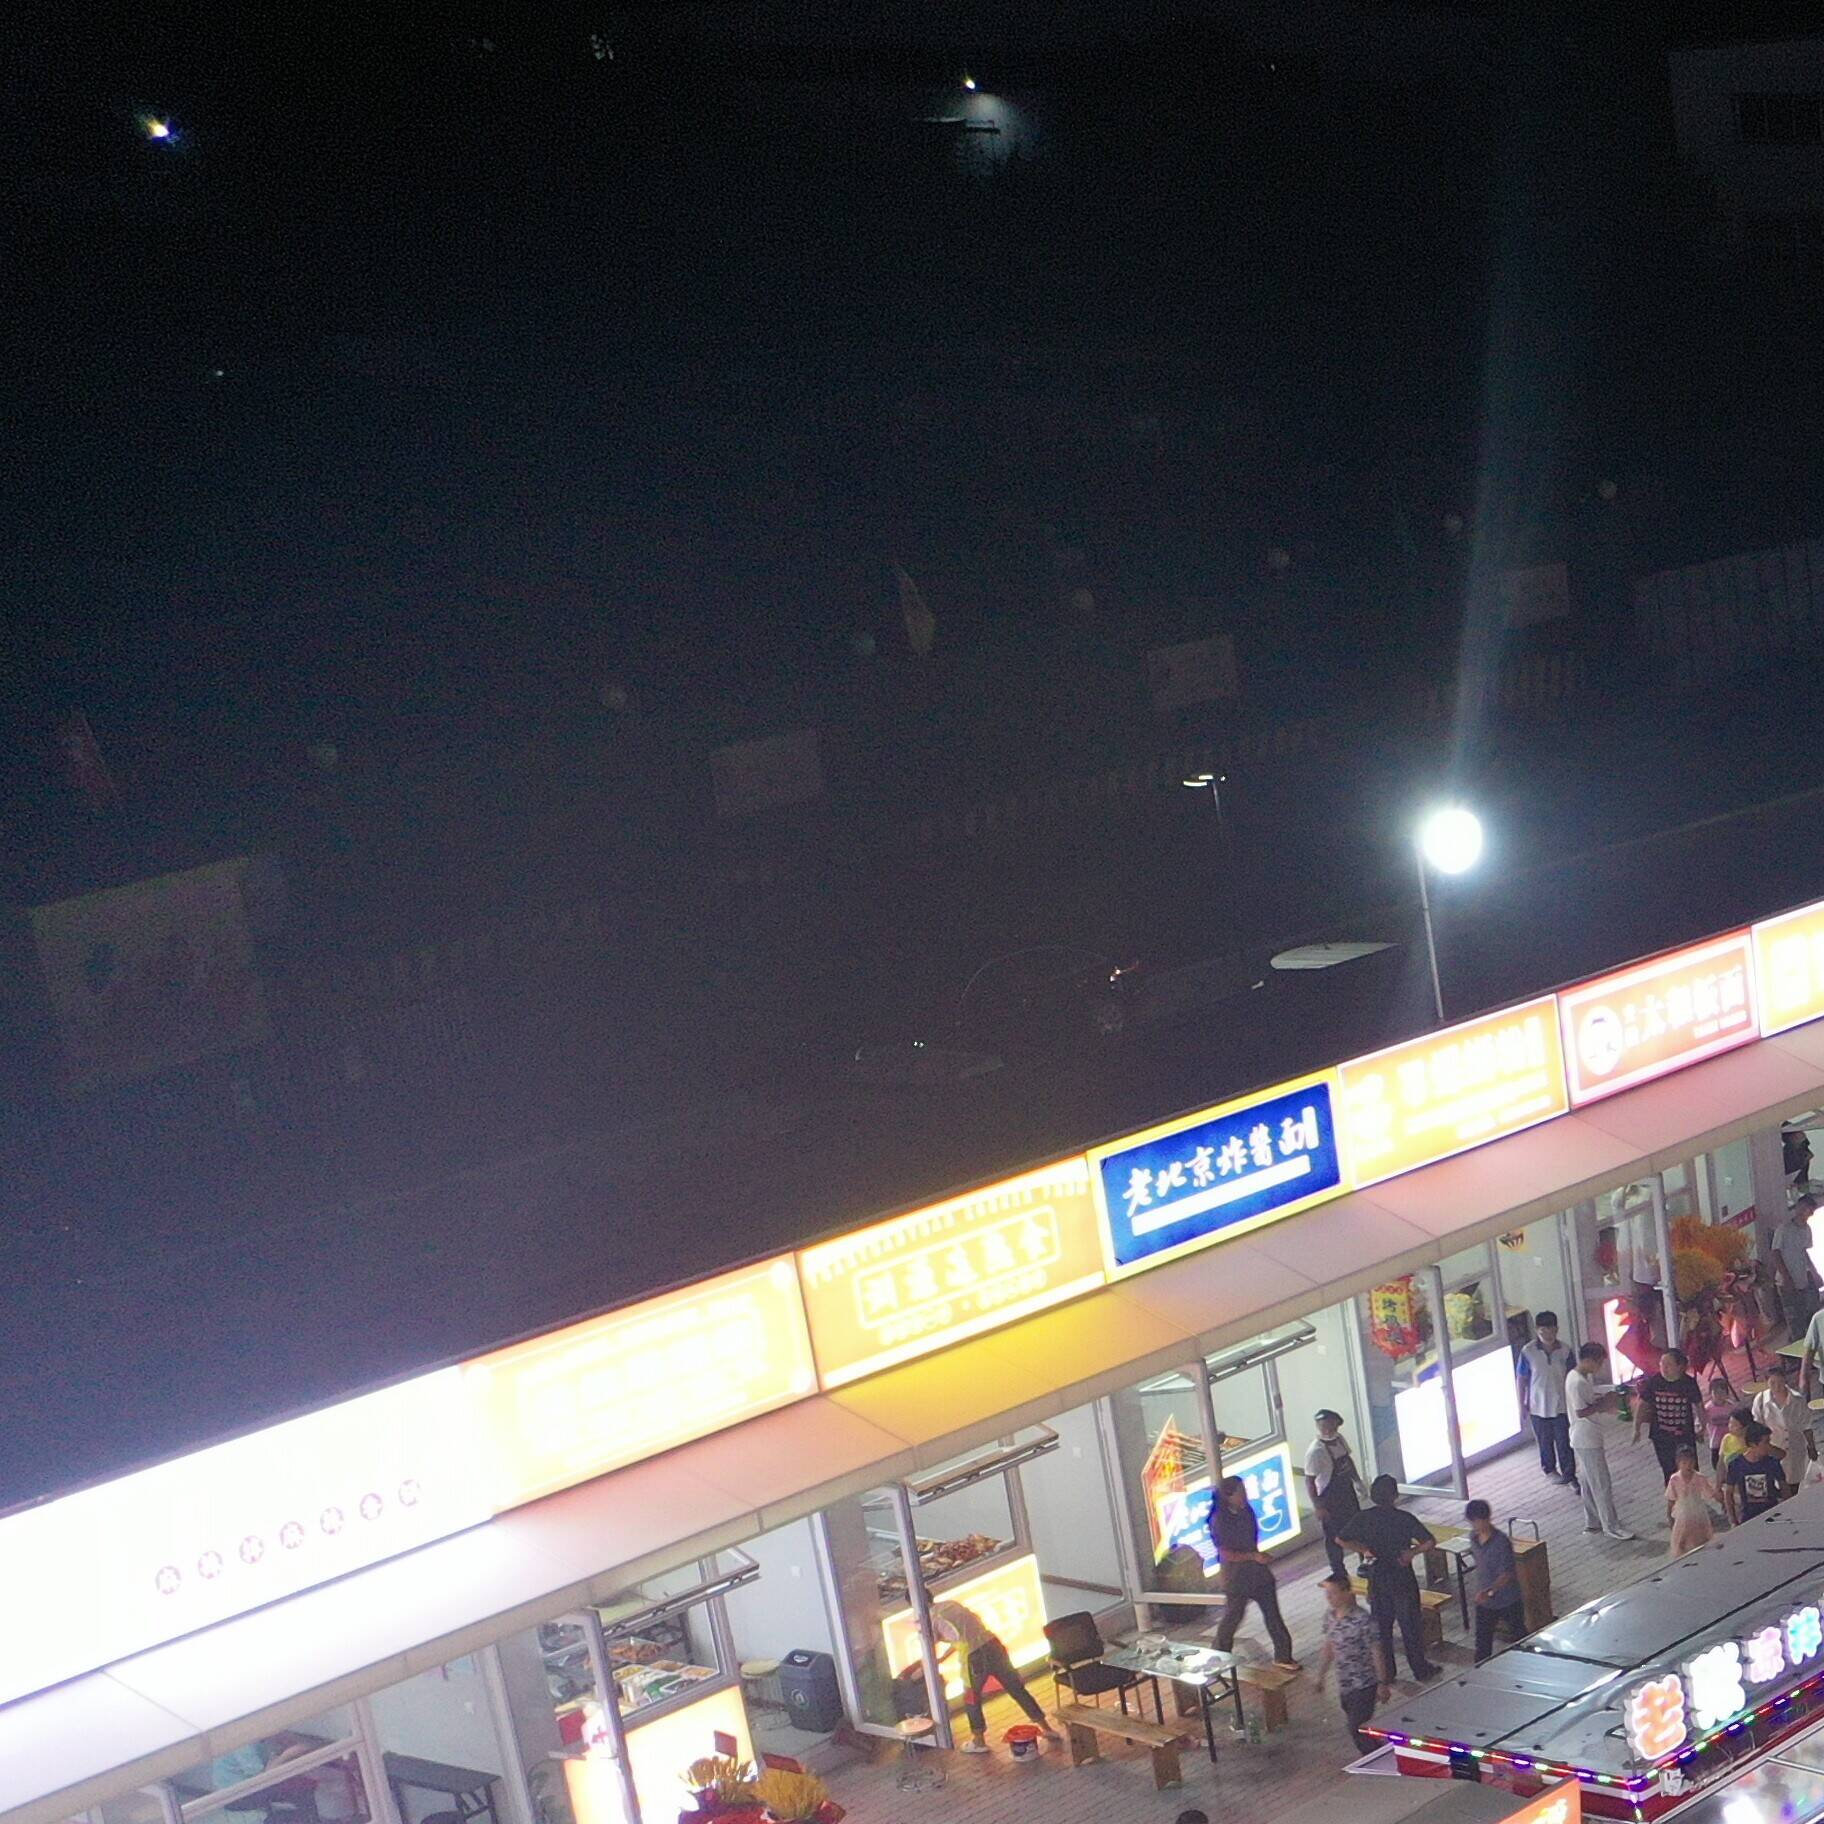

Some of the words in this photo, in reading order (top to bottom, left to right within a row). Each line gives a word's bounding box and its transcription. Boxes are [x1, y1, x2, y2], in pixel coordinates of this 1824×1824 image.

[1122, 1108, 1316, 1217] 老北京炸酱面
